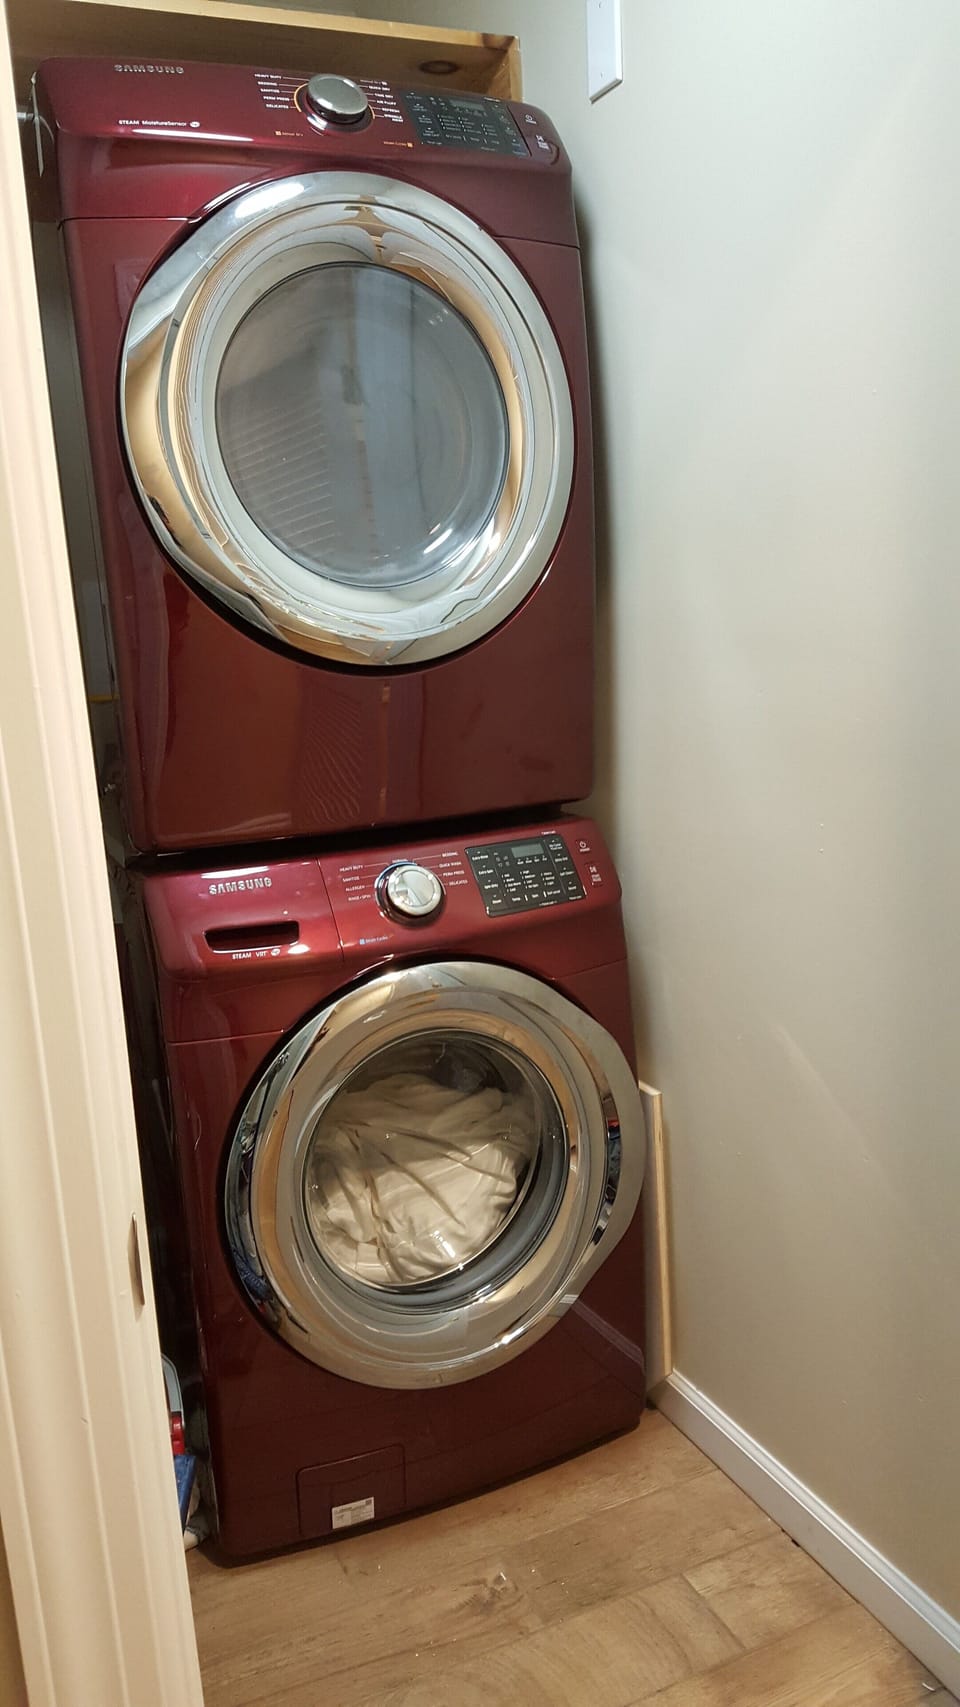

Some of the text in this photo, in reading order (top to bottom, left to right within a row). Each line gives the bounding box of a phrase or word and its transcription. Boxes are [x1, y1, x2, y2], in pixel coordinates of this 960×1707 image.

[114, 64, 185, 75] SAMSUNG
[208, 877, 272, 896] SAMSUNG
[231, 951, 252, 960] STEAM
